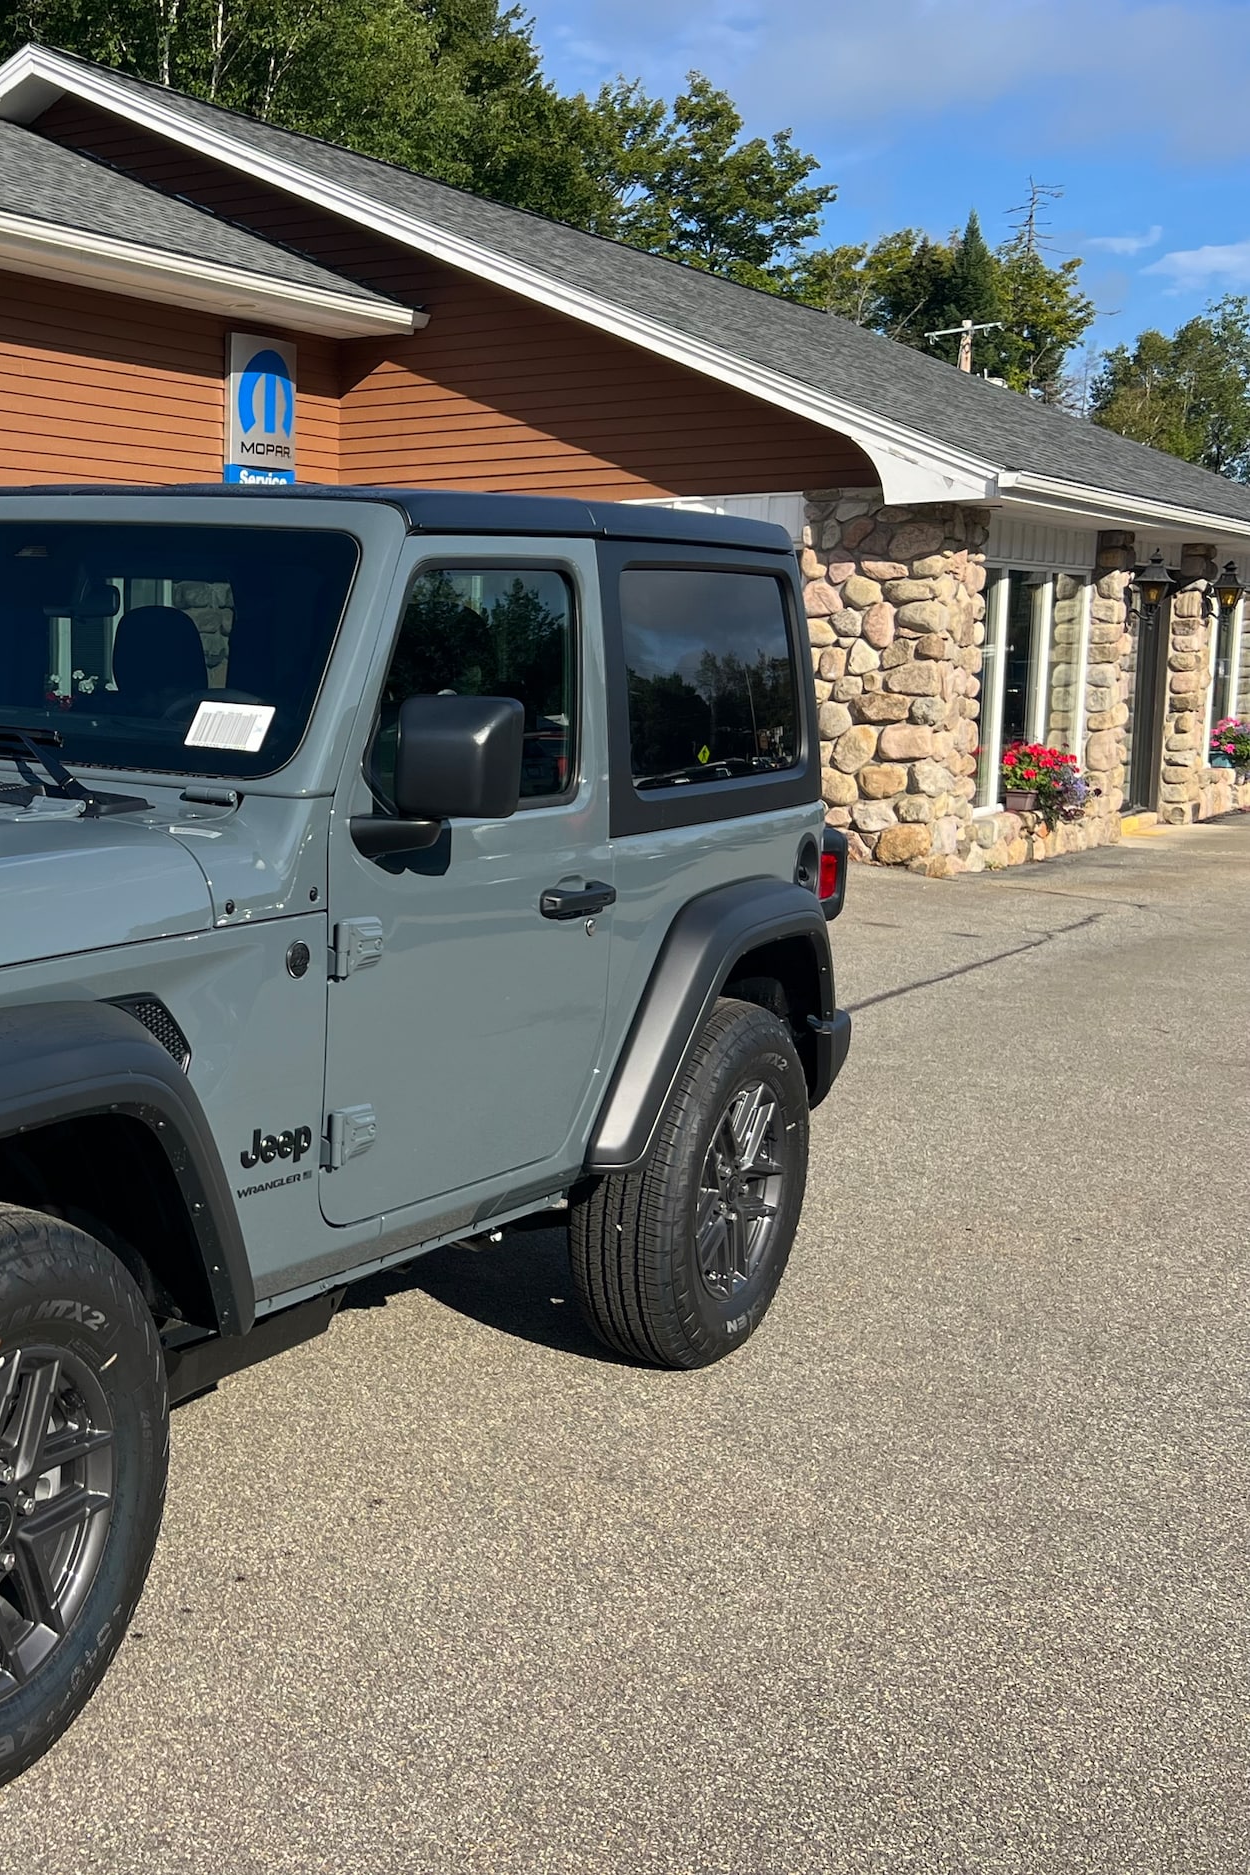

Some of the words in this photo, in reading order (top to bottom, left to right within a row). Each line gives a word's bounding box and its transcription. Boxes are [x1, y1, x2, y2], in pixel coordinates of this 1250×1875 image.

[240, 441, 291, 459] MOPAR
[240, 1125, 312, 1169] Jeep
[236, 1172, 302, 1200] WRANGLER
